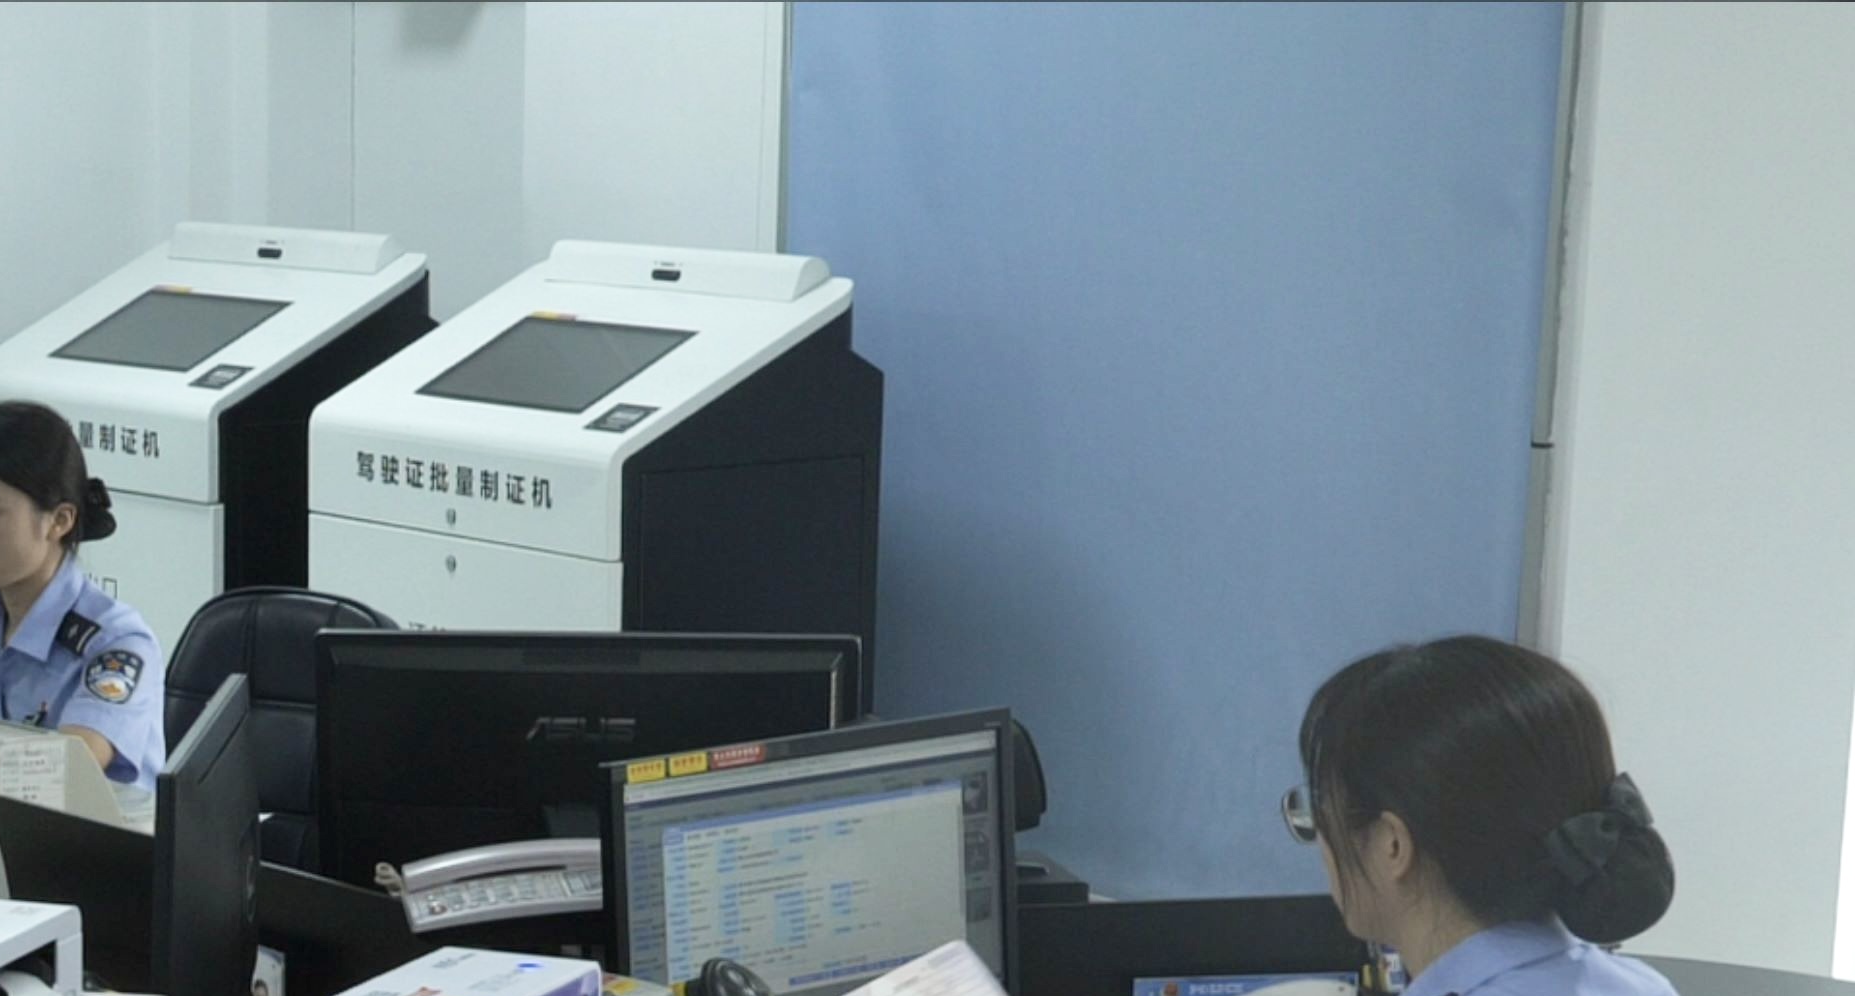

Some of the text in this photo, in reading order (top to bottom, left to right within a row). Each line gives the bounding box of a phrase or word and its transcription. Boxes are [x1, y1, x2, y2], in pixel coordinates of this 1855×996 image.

[357, 451, 552, 509] 驾驶证批量制证机
